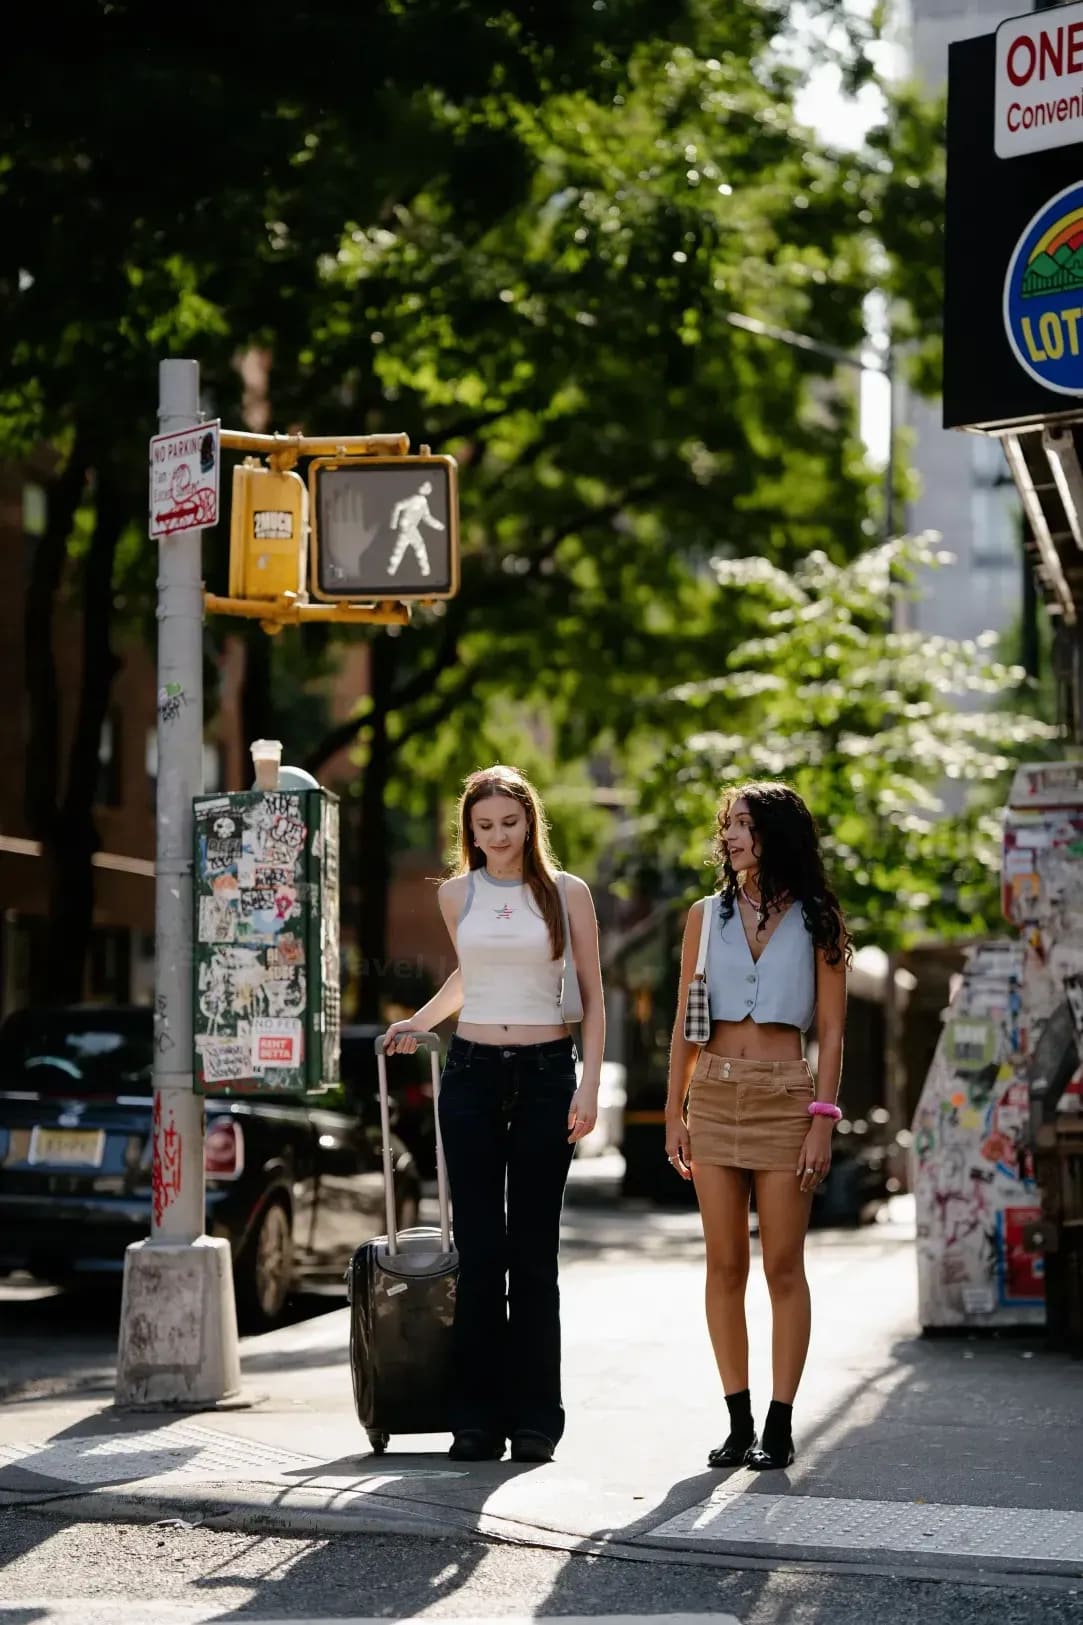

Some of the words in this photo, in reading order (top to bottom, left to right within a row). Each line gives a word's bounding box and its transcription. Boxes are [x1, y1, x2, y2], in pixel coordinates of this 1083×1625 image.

[1007, 21, 1083, 87] ONE
[1020, 307, 1083, 363] LOT
[154, 445, 166, 463] NO
[255, 1018, 273, 1028] NO
[277, 1019, 298, 1029] FEE
